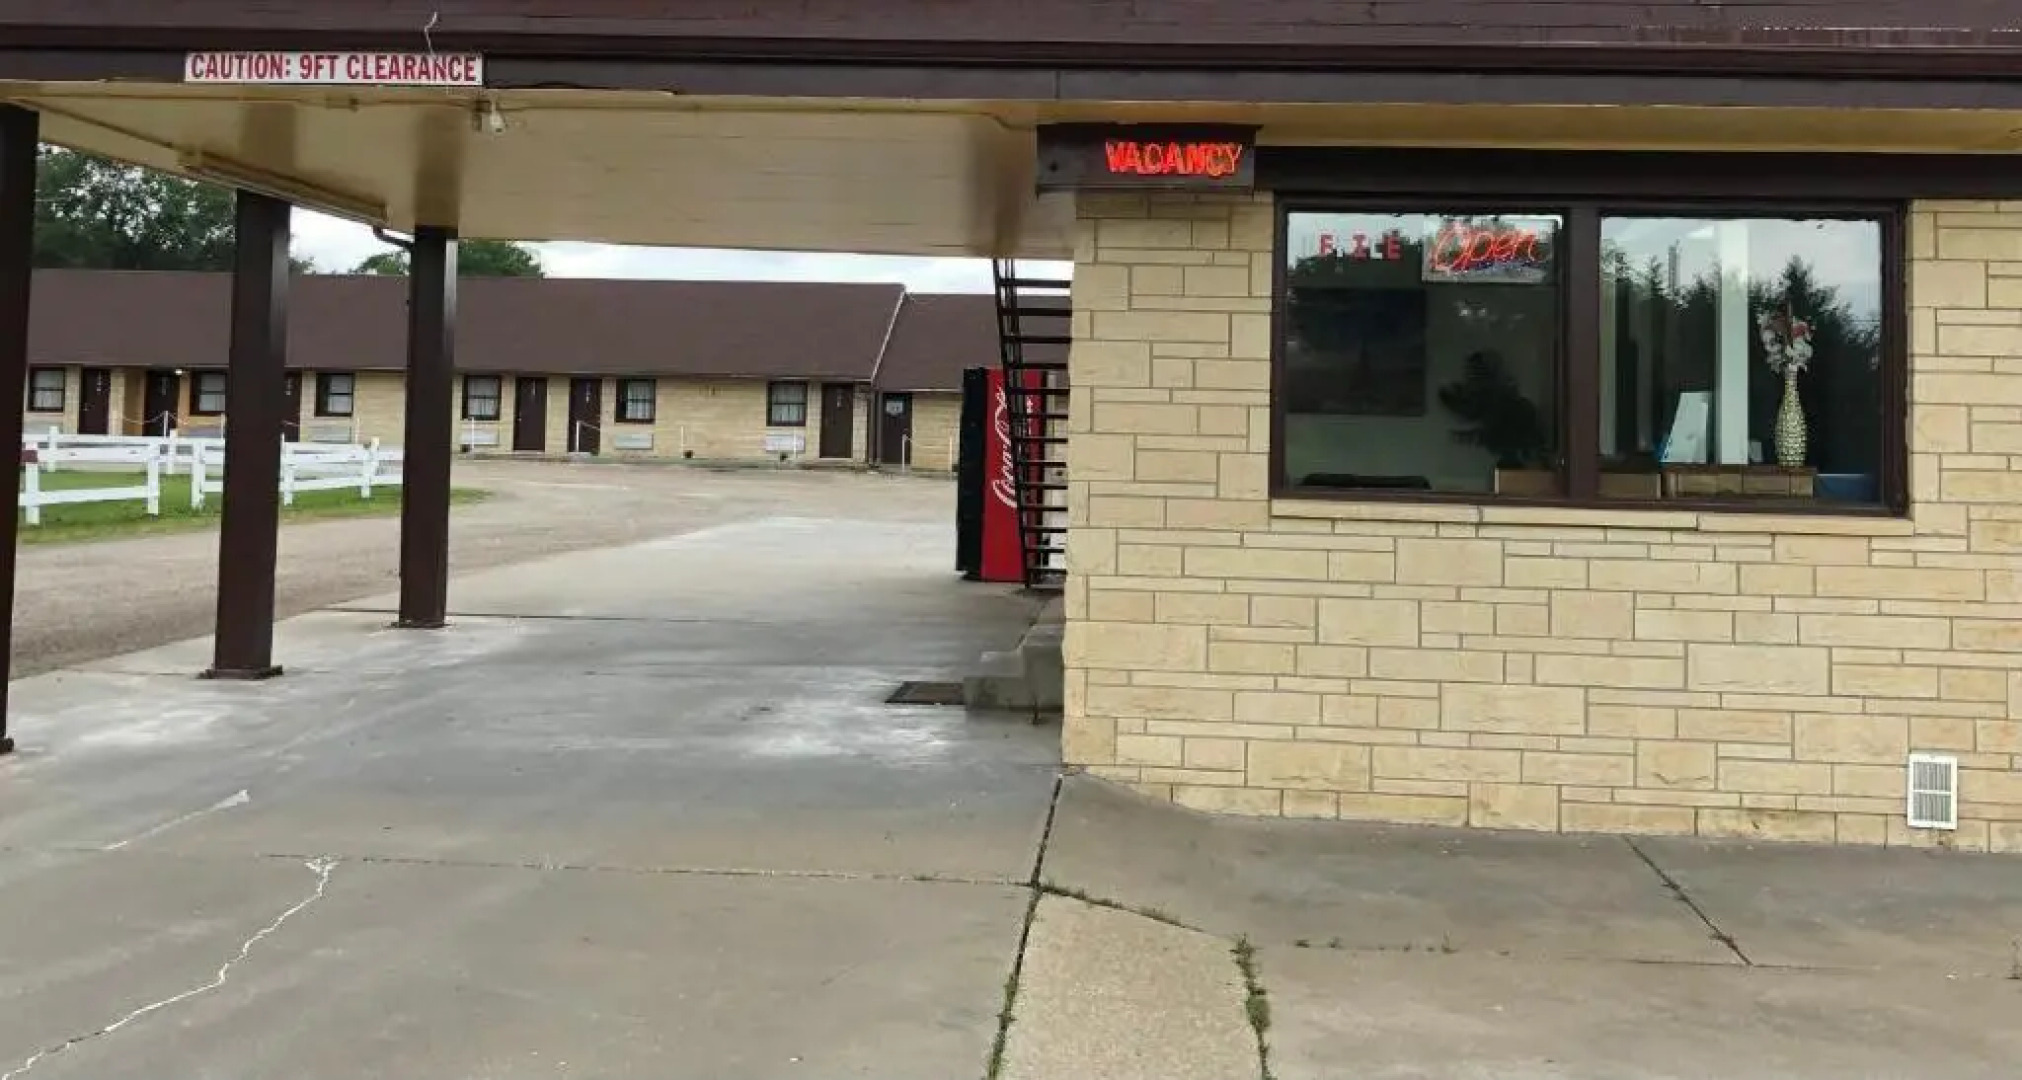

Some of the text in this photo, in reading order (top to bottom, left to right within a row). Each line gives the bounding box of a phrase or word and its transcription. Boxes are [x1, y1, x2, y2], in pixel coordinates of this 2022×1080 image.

[190, 54, 477, 82] CAUTION: 9FT CLEARANCE
[1105, 141, 1243, 176] VACANCY
[1428, 221, 1545, 275] Open
